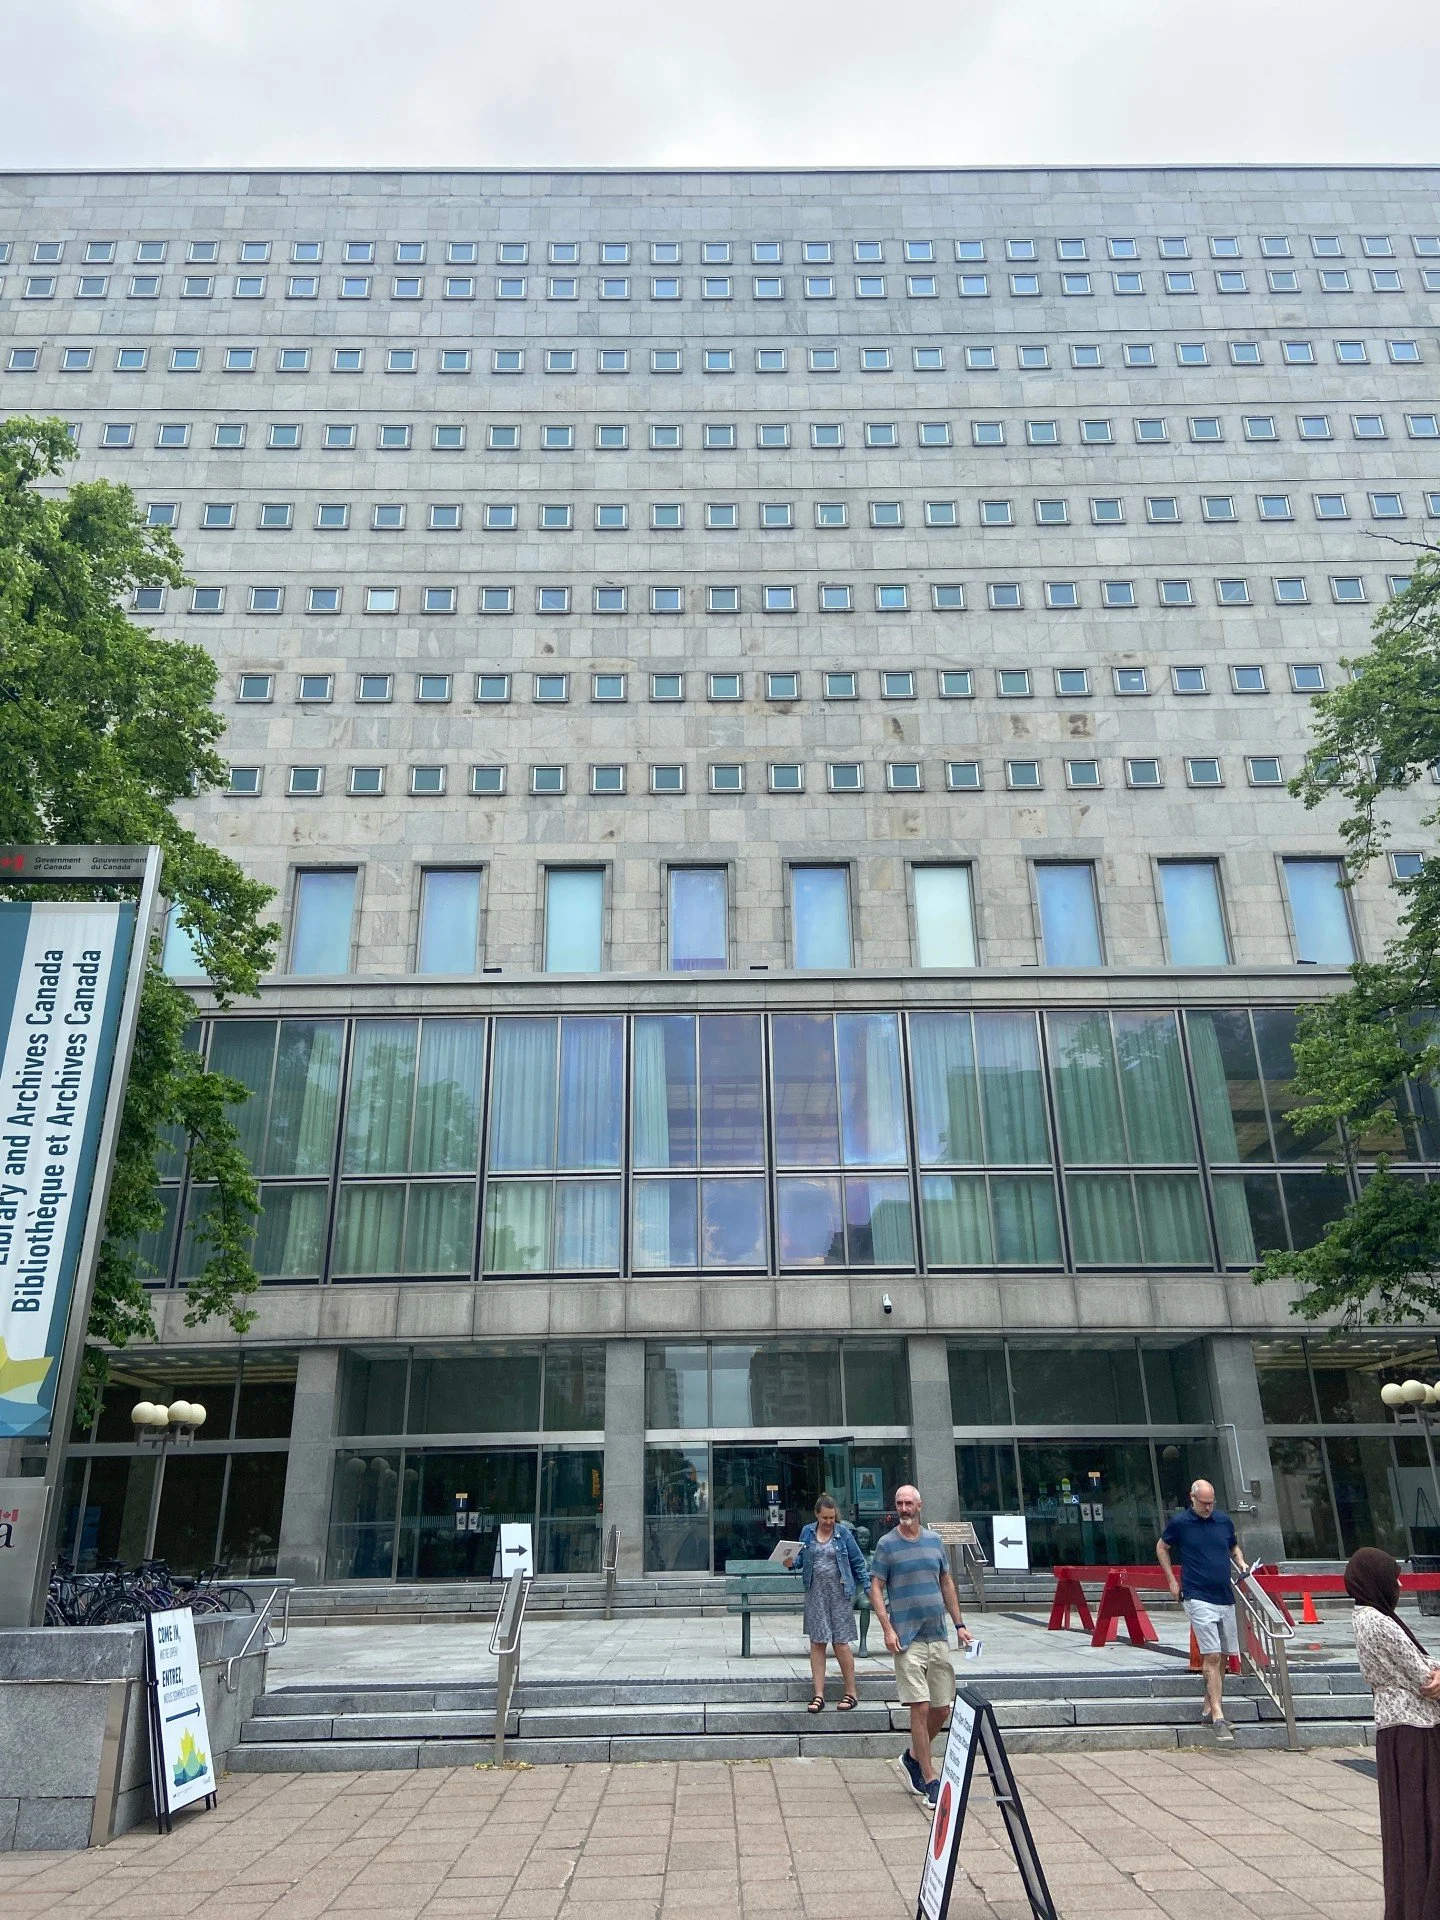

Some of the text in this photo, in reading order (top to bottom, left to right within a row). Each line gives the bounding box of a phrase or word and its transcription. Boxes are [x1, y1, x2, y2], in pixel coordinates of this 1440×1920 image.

[25, 950, 64, 1025] Canada
[6, 1033, 49, 1127] Archives
[2, 1135, 31, 1176] and
[11, 950, 102, 1312] Bibliothèque et Archives Canada
[157, 1625, 173, 1644] COME
[162, 1665, 184, 1688] ENTREZ,
